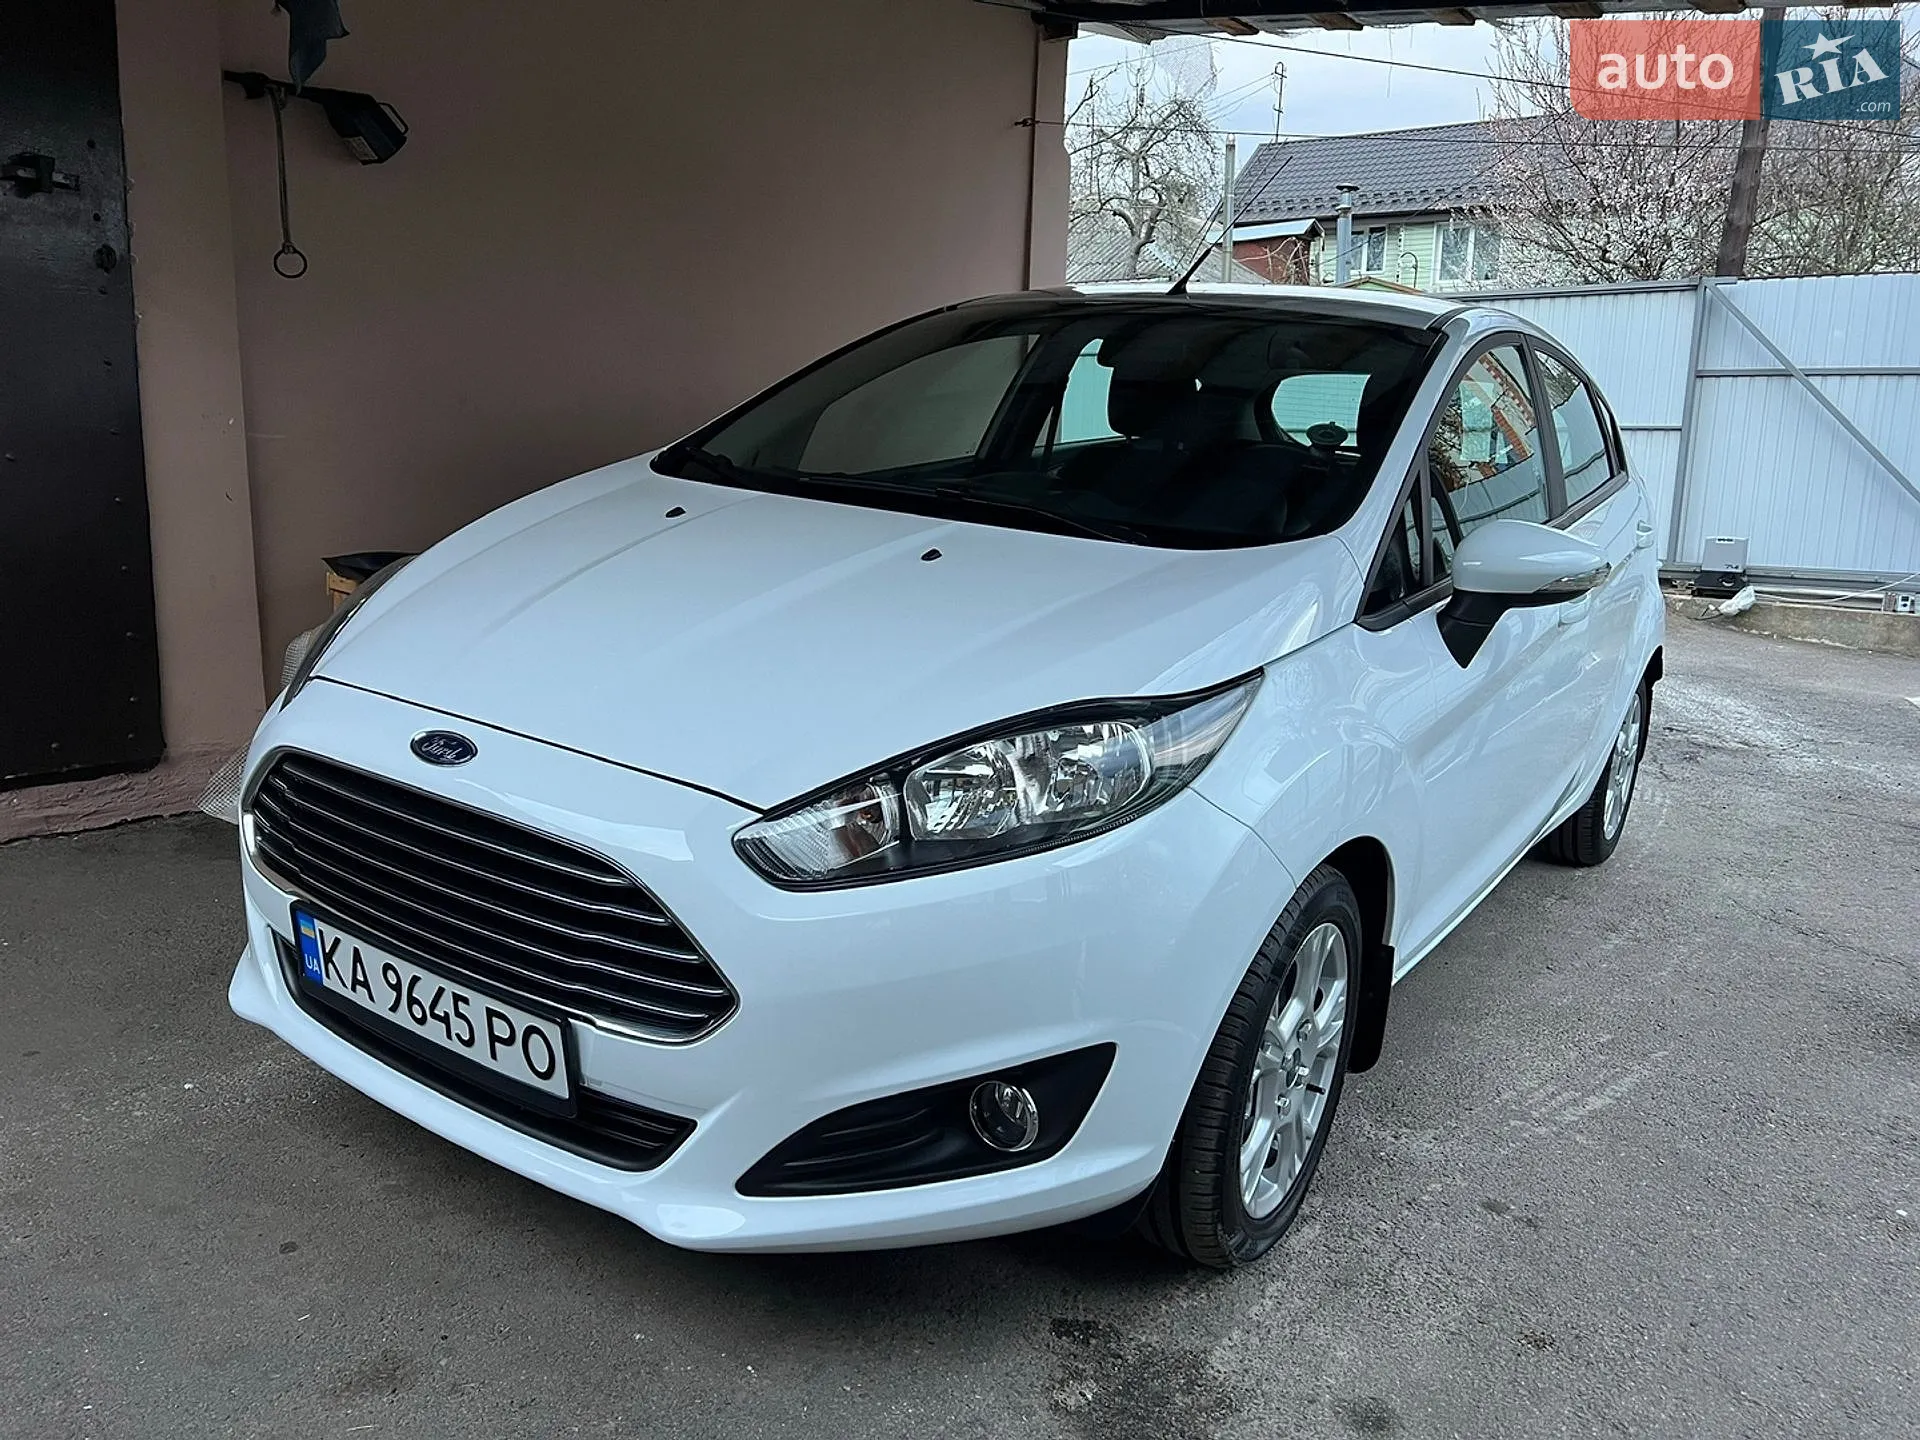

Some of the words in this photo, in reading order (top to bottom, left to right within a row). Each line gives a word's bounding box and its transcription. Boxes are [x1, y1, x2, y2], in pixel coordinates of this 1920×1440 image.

[421, 737, 463, 759] Ford
[304, 953, 320, 975] UA
[318, 927, 376, 1004] KA
[381, 962, 476, 1049] 9645
[485, 1006, 557, 1081] PO
